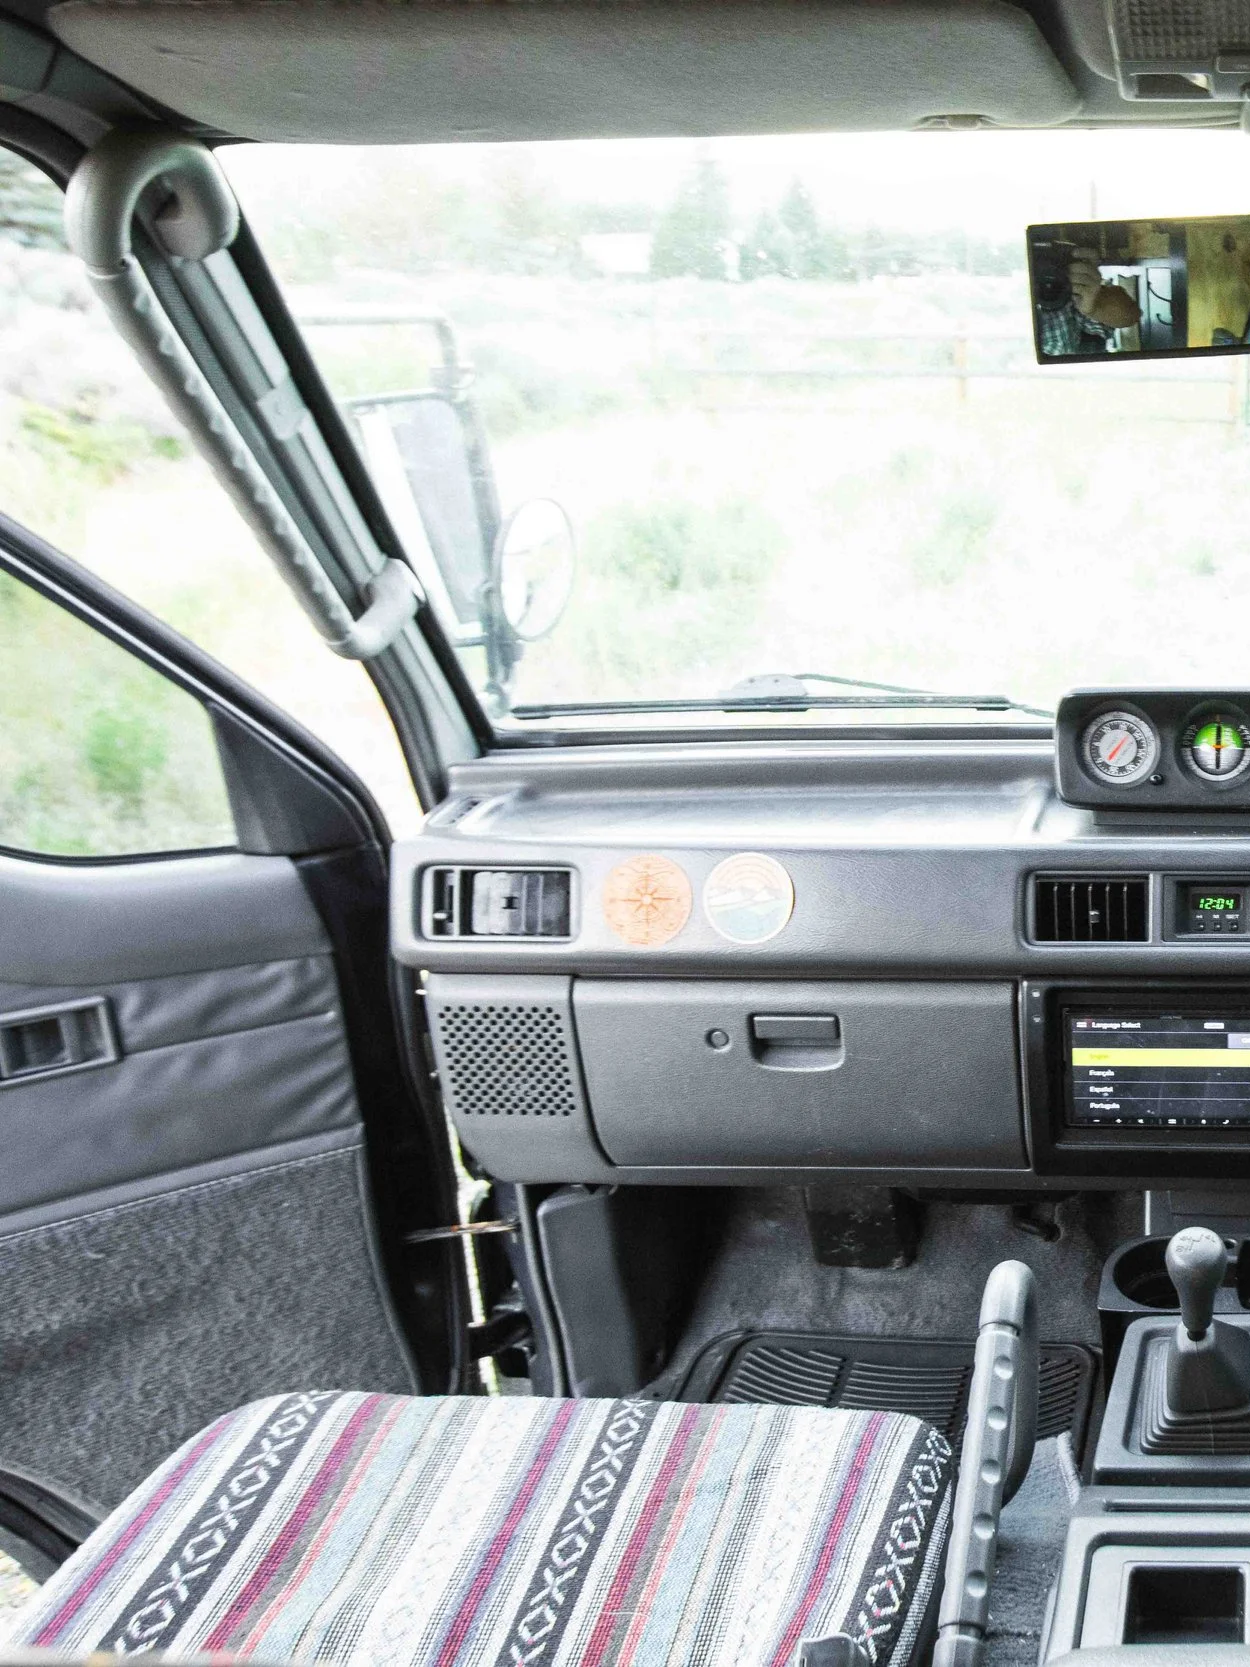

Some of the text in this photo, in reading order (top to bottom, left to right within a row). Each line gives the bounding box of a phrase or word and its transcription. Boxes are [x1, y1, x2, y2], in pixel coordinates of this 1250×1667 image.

[1199, 898, 1234, 909] 12:04
[1091, 1021, 1141, 1030] Language Select
